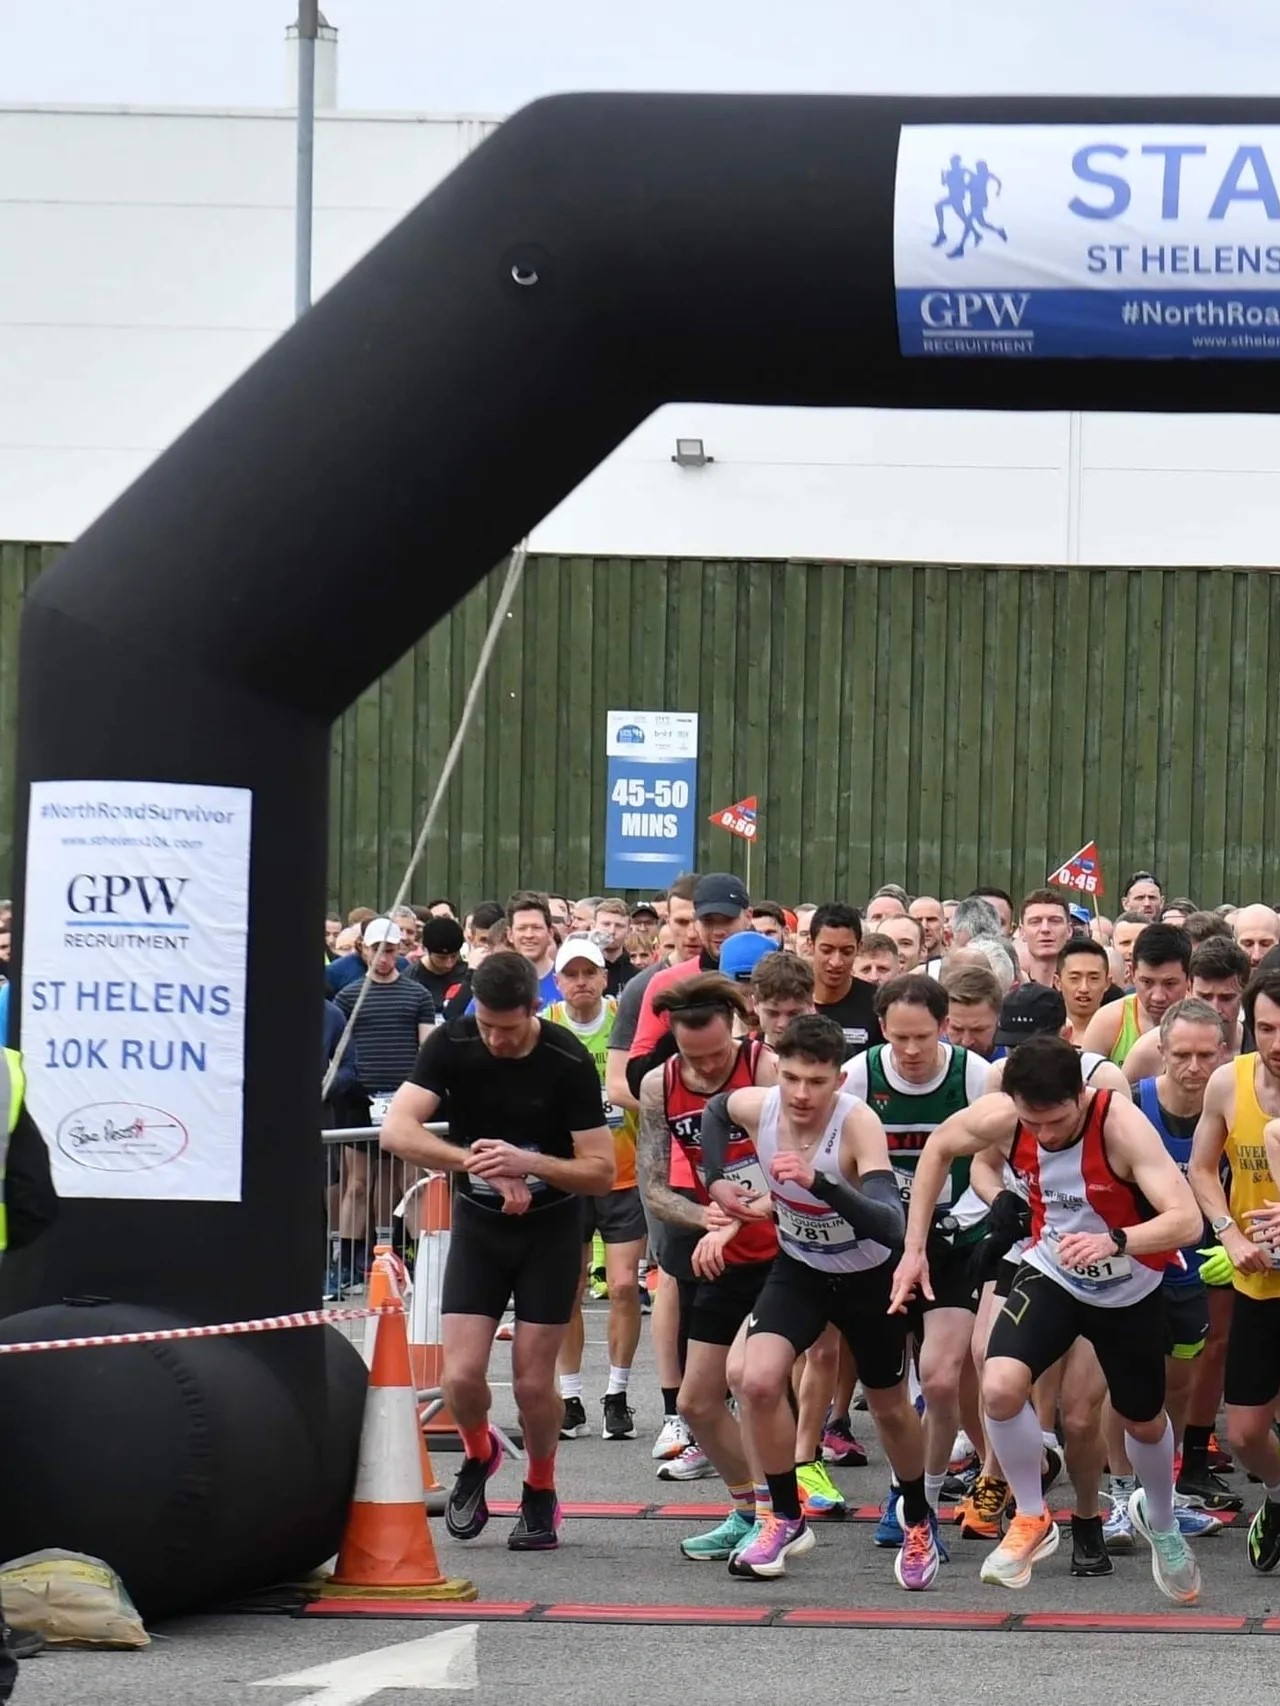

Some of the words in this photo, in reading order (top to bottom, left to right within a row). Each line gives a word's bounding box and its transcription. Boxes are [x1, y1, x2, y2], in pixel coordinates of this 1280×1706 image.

[1087, 245, 1132, 275] ST
[920, 291, 1031, 328] GPW
[923, 338, 1034, 353] RECRUITMENT
[612, 778, 689, 809] 45-50
[40, 802, 235, 827] #NorthRoadSurvivor
[621, 813, 678, 838] MINS
[1059, 868, 1098, 893] 0:45
[67, 873, 190, 917] GPW
[64, 933, 190, 951] RECRUITMENT
[31, 981, 66, 1012] ST
[76, 981, 232, 1017] HELENS
[45, 1038, 109, 1069] 10K
[121, 1039, 208, 1073] RUN
[792, 1223, 829, 1241] 781
